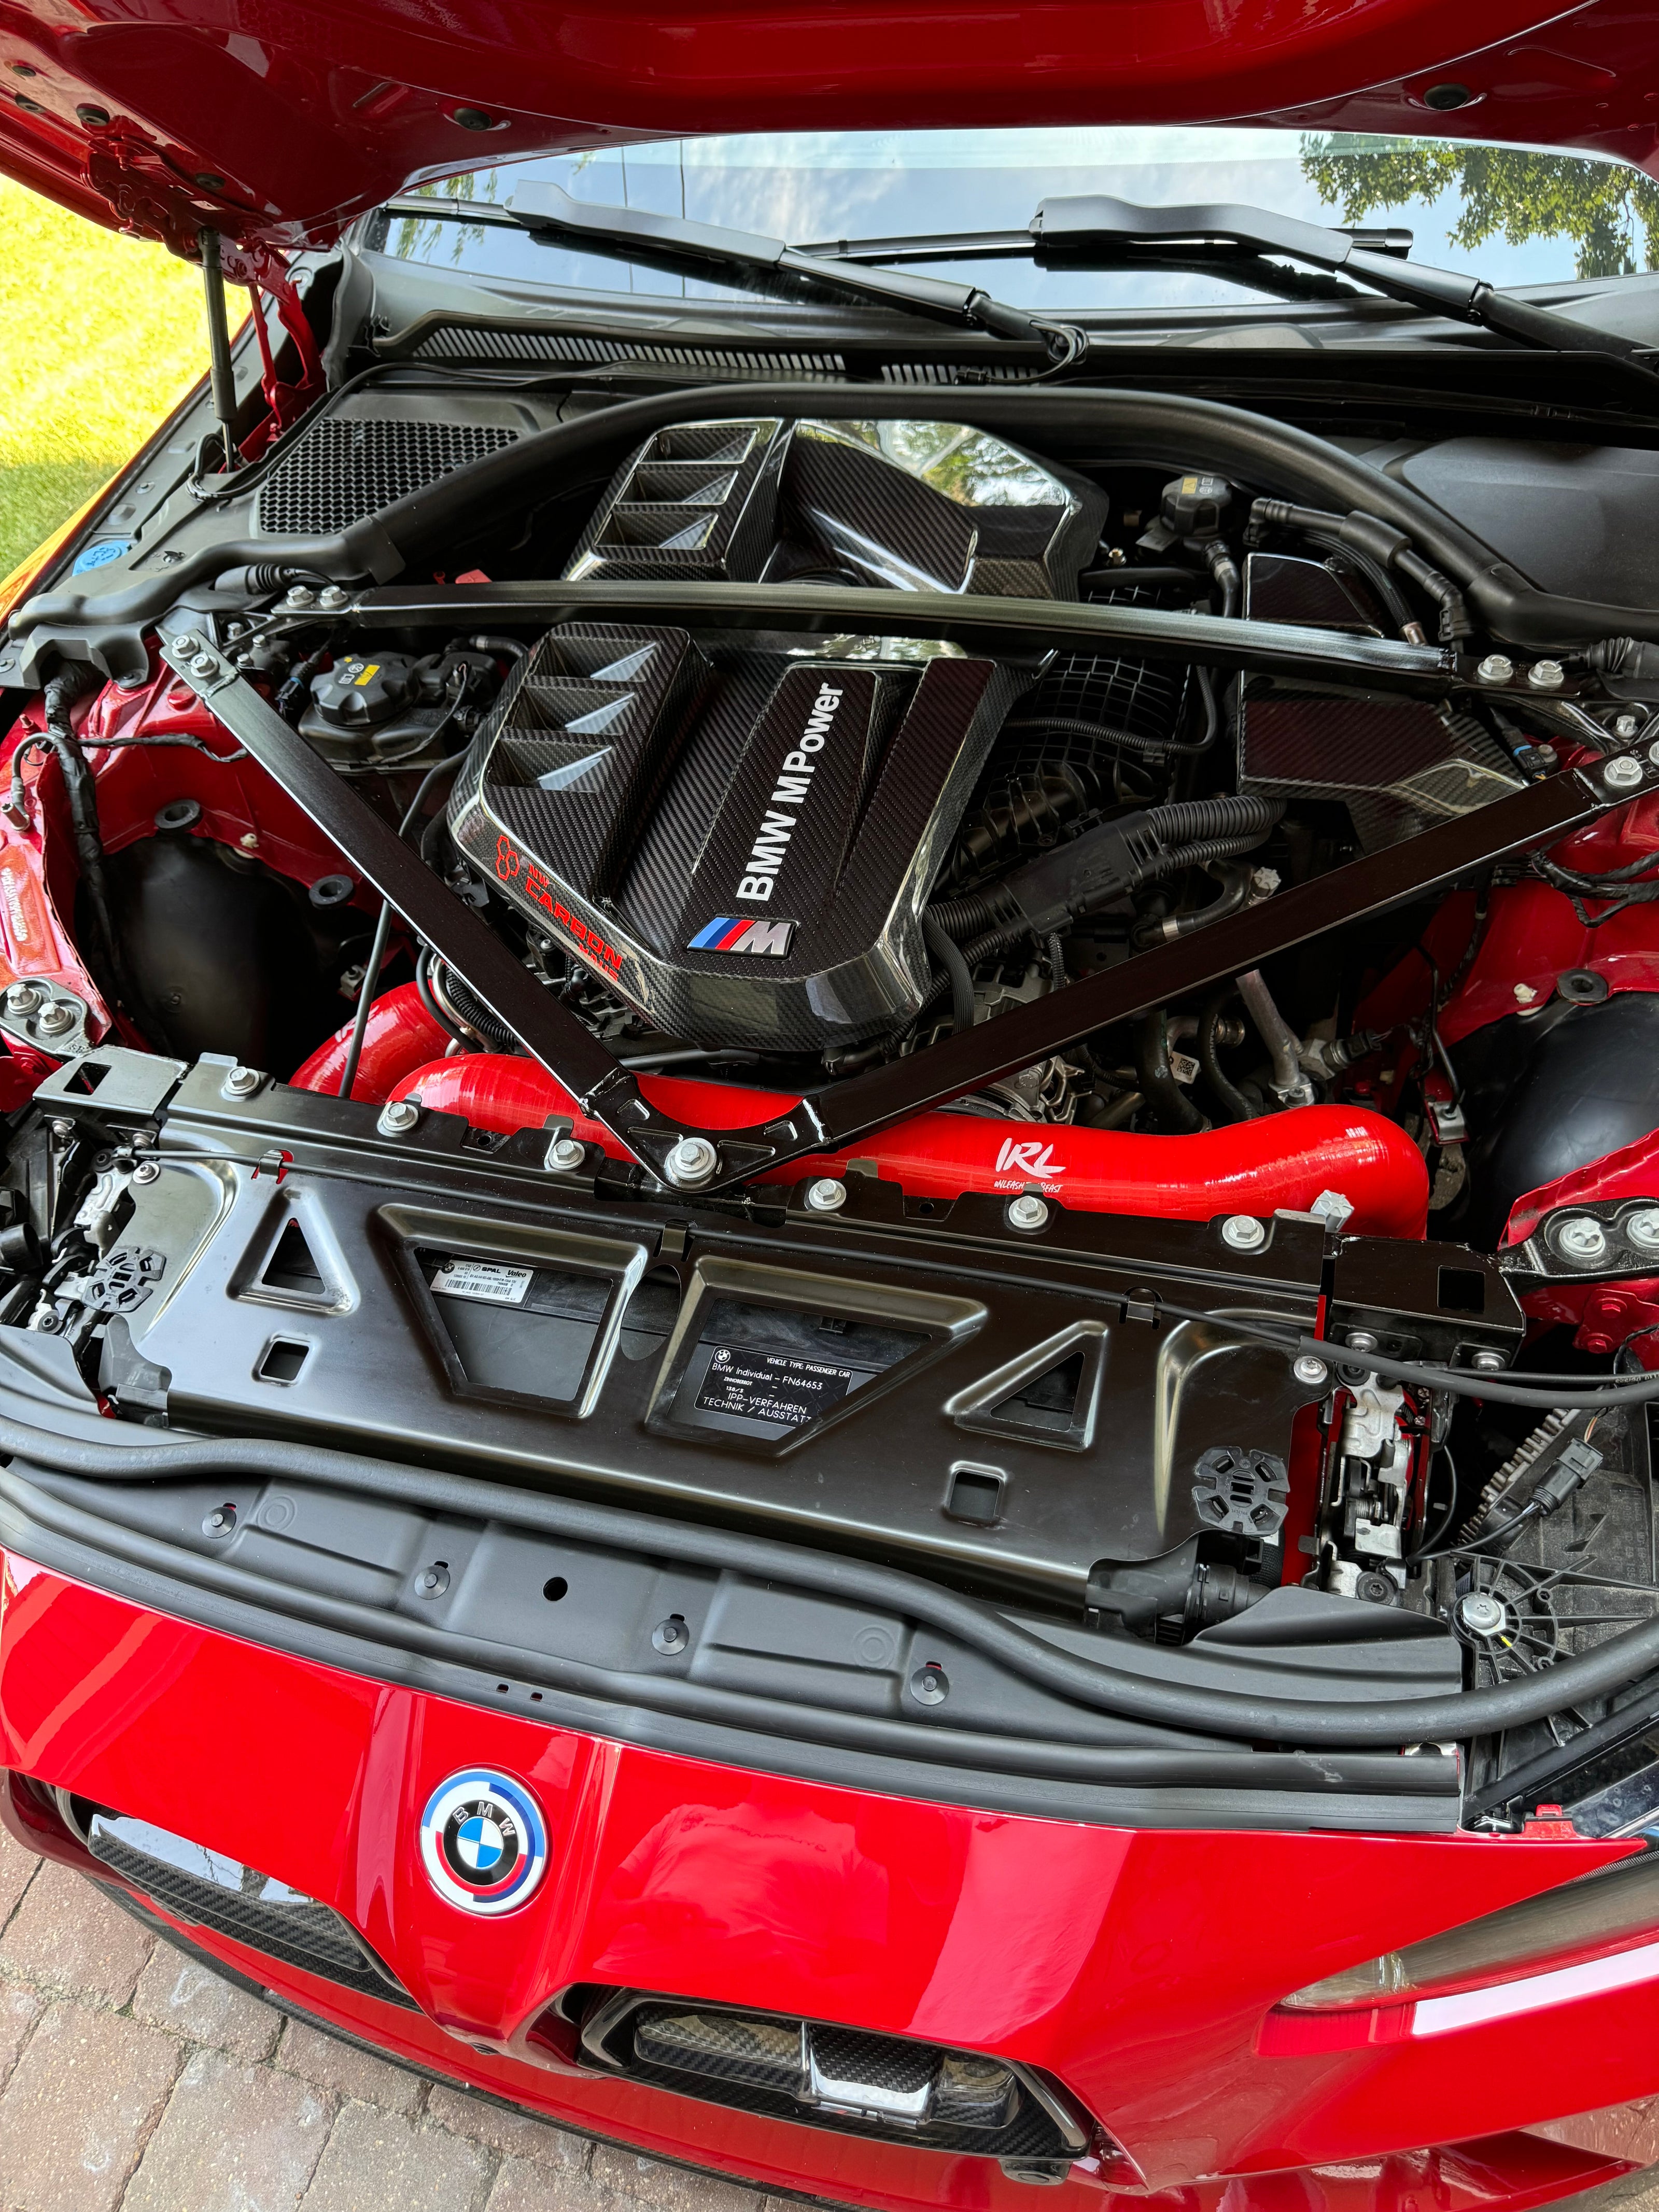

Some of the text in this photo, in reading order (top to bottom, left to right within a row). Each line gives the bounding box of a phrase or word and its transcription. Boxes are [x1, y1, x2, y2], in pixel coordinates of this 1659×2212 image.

[736, 682, 843, 901] BMW MPower
[529, 864, 550, 887] NW
[525, 876, 623, 970] CARBON
[730, 920, 792, 955] M
[579, 942, 619, 982] HAUS
[995, 1137, 1066, 1179] IRL
[712, 1362, 734, 1373] BMW
[736, 1367, 772, 1380] Individual
[782, 1376, 823, 1390] FN64653
[767, 1357, 787, 1366] VEHICLE
[790, 1361, 804, 1369] TYPE:
[805, 1364, 837, 1375] PASSENGER
[703, 1396, 744, 1411] TECHNIK
[728, 1392, 807, 1414] IPP-VERFAHREN
[452, 1801, 516, 1837] BMW
